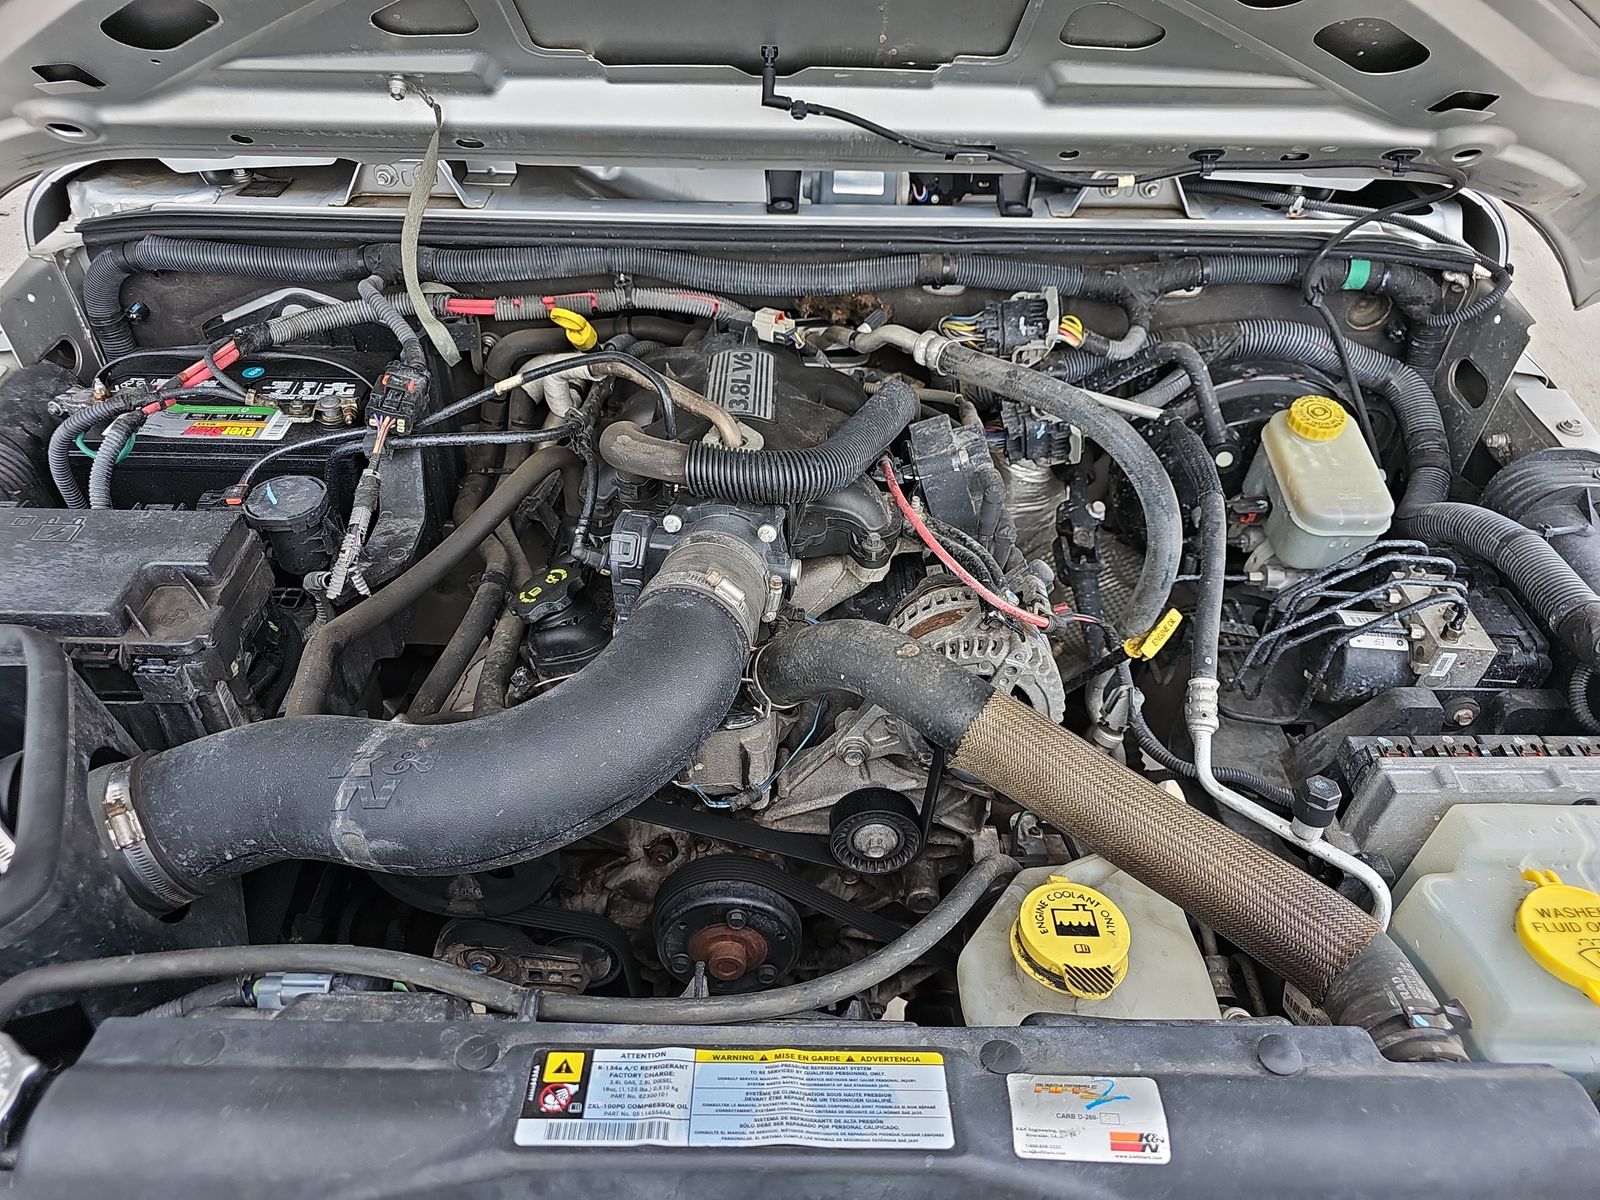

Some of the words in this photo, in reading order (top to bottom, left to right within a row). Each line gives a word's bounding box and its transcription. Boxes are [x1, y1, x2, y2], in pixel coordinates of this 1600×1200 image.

[732, 352, 754, 373] V6
[728, 374, 752, 411] 3.8L
[182, 426, 258, 438] EverStart
[1034, 900, 1049, 935] ENGINE
[1046, 890, 1102, 908] COOLANT
[1100, 910, 1116, 936] ONLY
[1532, 922, 1582, 933] FLUID
[620, 1051, 667, 1059] ATTENTION
[628, 1102, 675, 1110] COMPRESSOR
[1138, 1132, 1164, 1152] K&N
